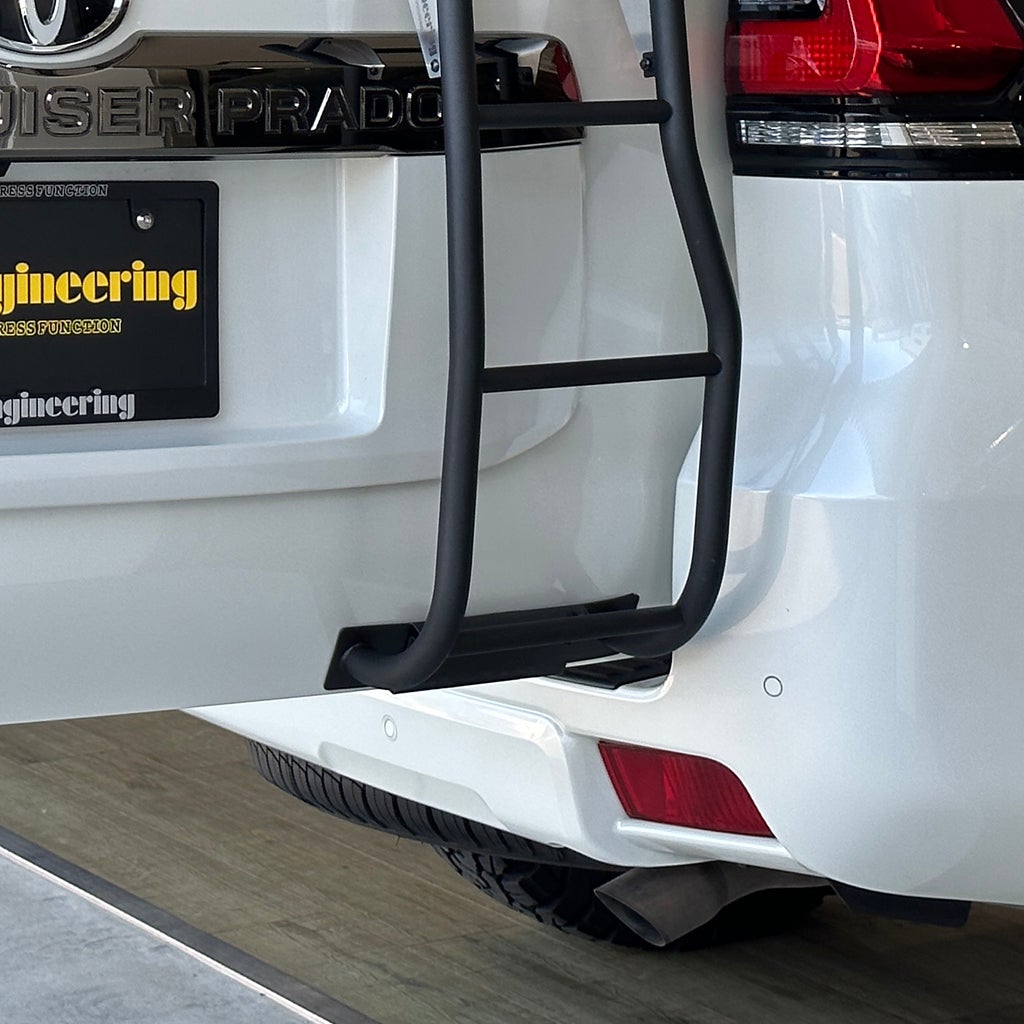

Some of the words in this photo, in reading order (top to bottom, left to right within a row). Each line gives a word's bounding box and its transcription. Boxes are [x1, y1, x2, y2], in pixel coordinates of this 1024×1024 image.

[217, 84, 444, 136] PRADO
[35, 183, 108, 197] FUNCTION
[37, 318, 122, 336] FUNCTION
